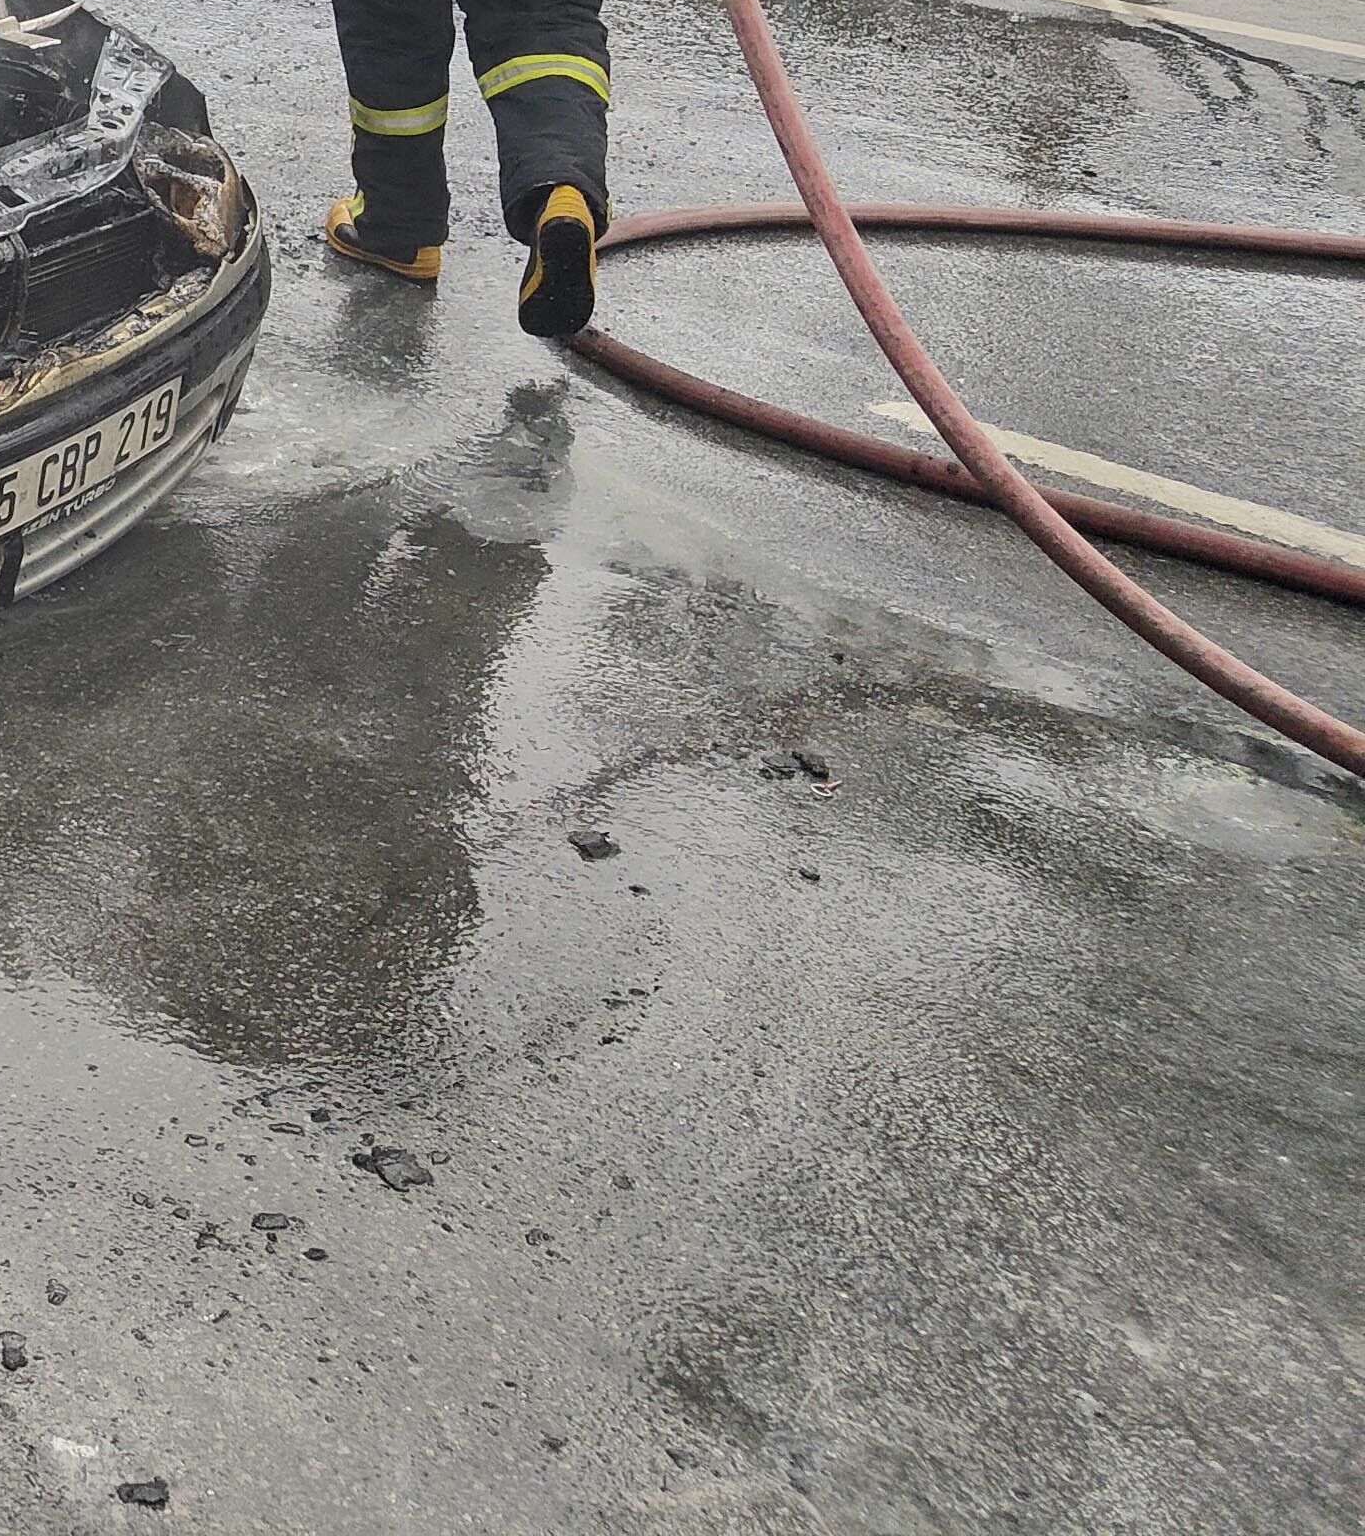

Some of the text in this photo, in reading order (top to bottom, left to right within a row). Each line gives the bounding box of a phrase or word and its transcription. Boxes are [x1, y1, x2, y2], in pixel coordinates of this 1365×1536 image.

[36, 430, 102, 508] CBP
[114, 388, 174, 466] 219
[63, 476, 117, 517] TURBO
